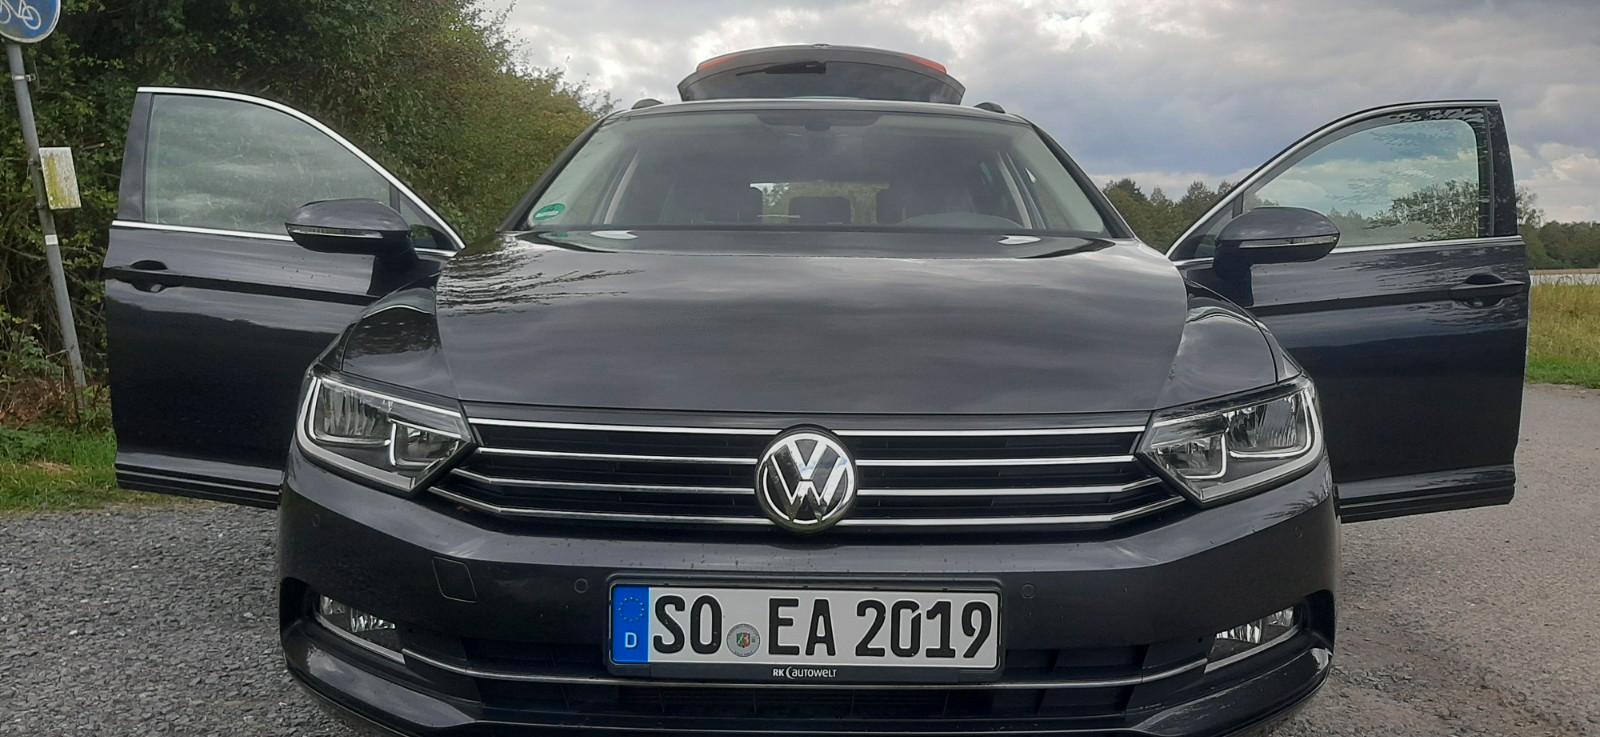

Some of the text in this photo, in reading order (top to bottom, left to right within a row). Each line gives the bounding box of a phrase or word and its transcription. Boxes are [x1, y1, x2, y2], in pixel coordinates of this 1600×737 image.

[758, 433, 854, 524] VW
[625, 632, 637, 648] D
[652, 595, 992, 659] SO EA 2019
[772, 668, 785, 677] RK
